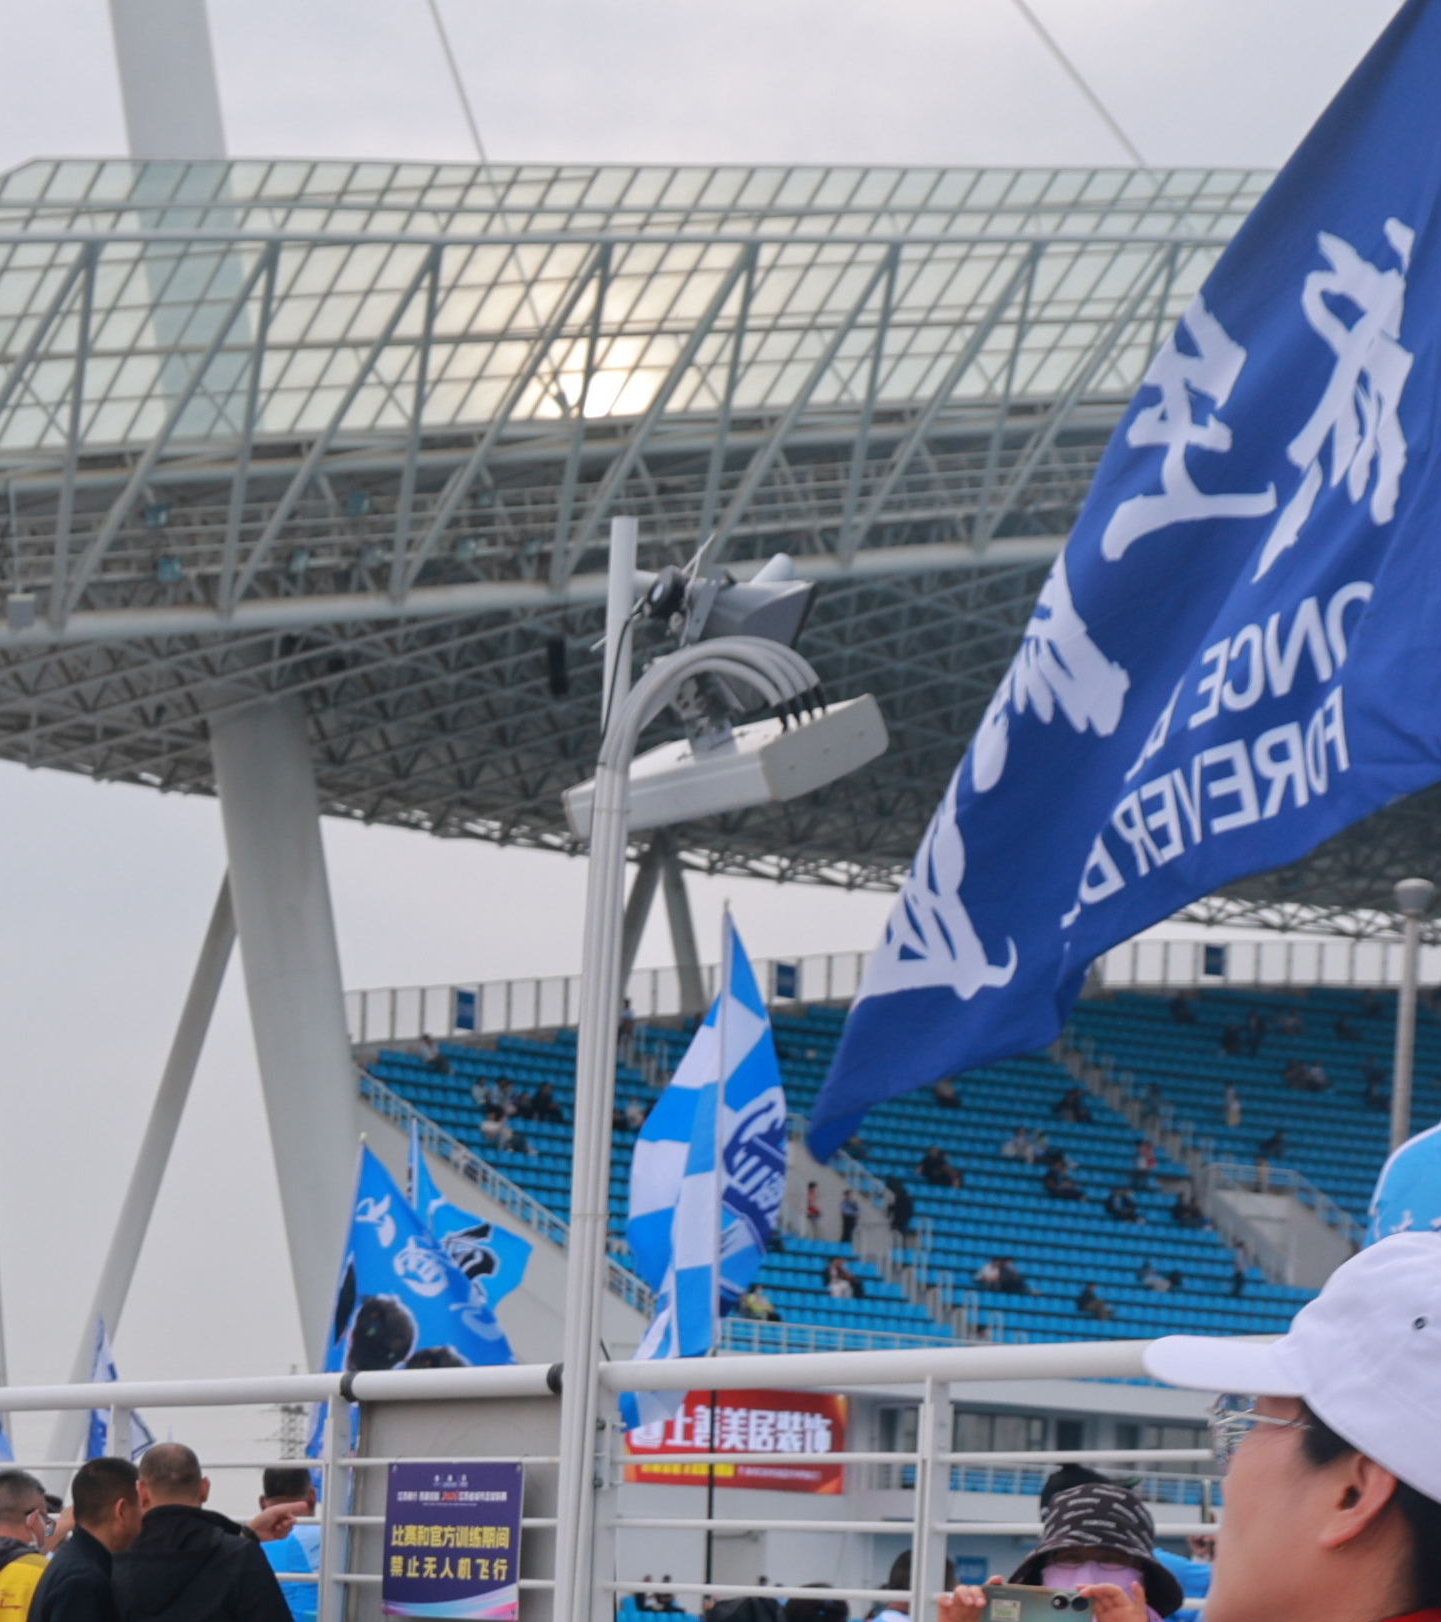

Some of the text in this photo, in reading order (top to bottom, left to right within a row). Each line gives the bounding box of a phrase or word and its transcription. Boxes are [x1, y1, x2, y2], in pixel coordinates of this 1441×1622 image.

[391, 1525, 510, 1549] 比赛和官方训练期间
[390, 1556, 508, 1581] 禁止无人机飞行
